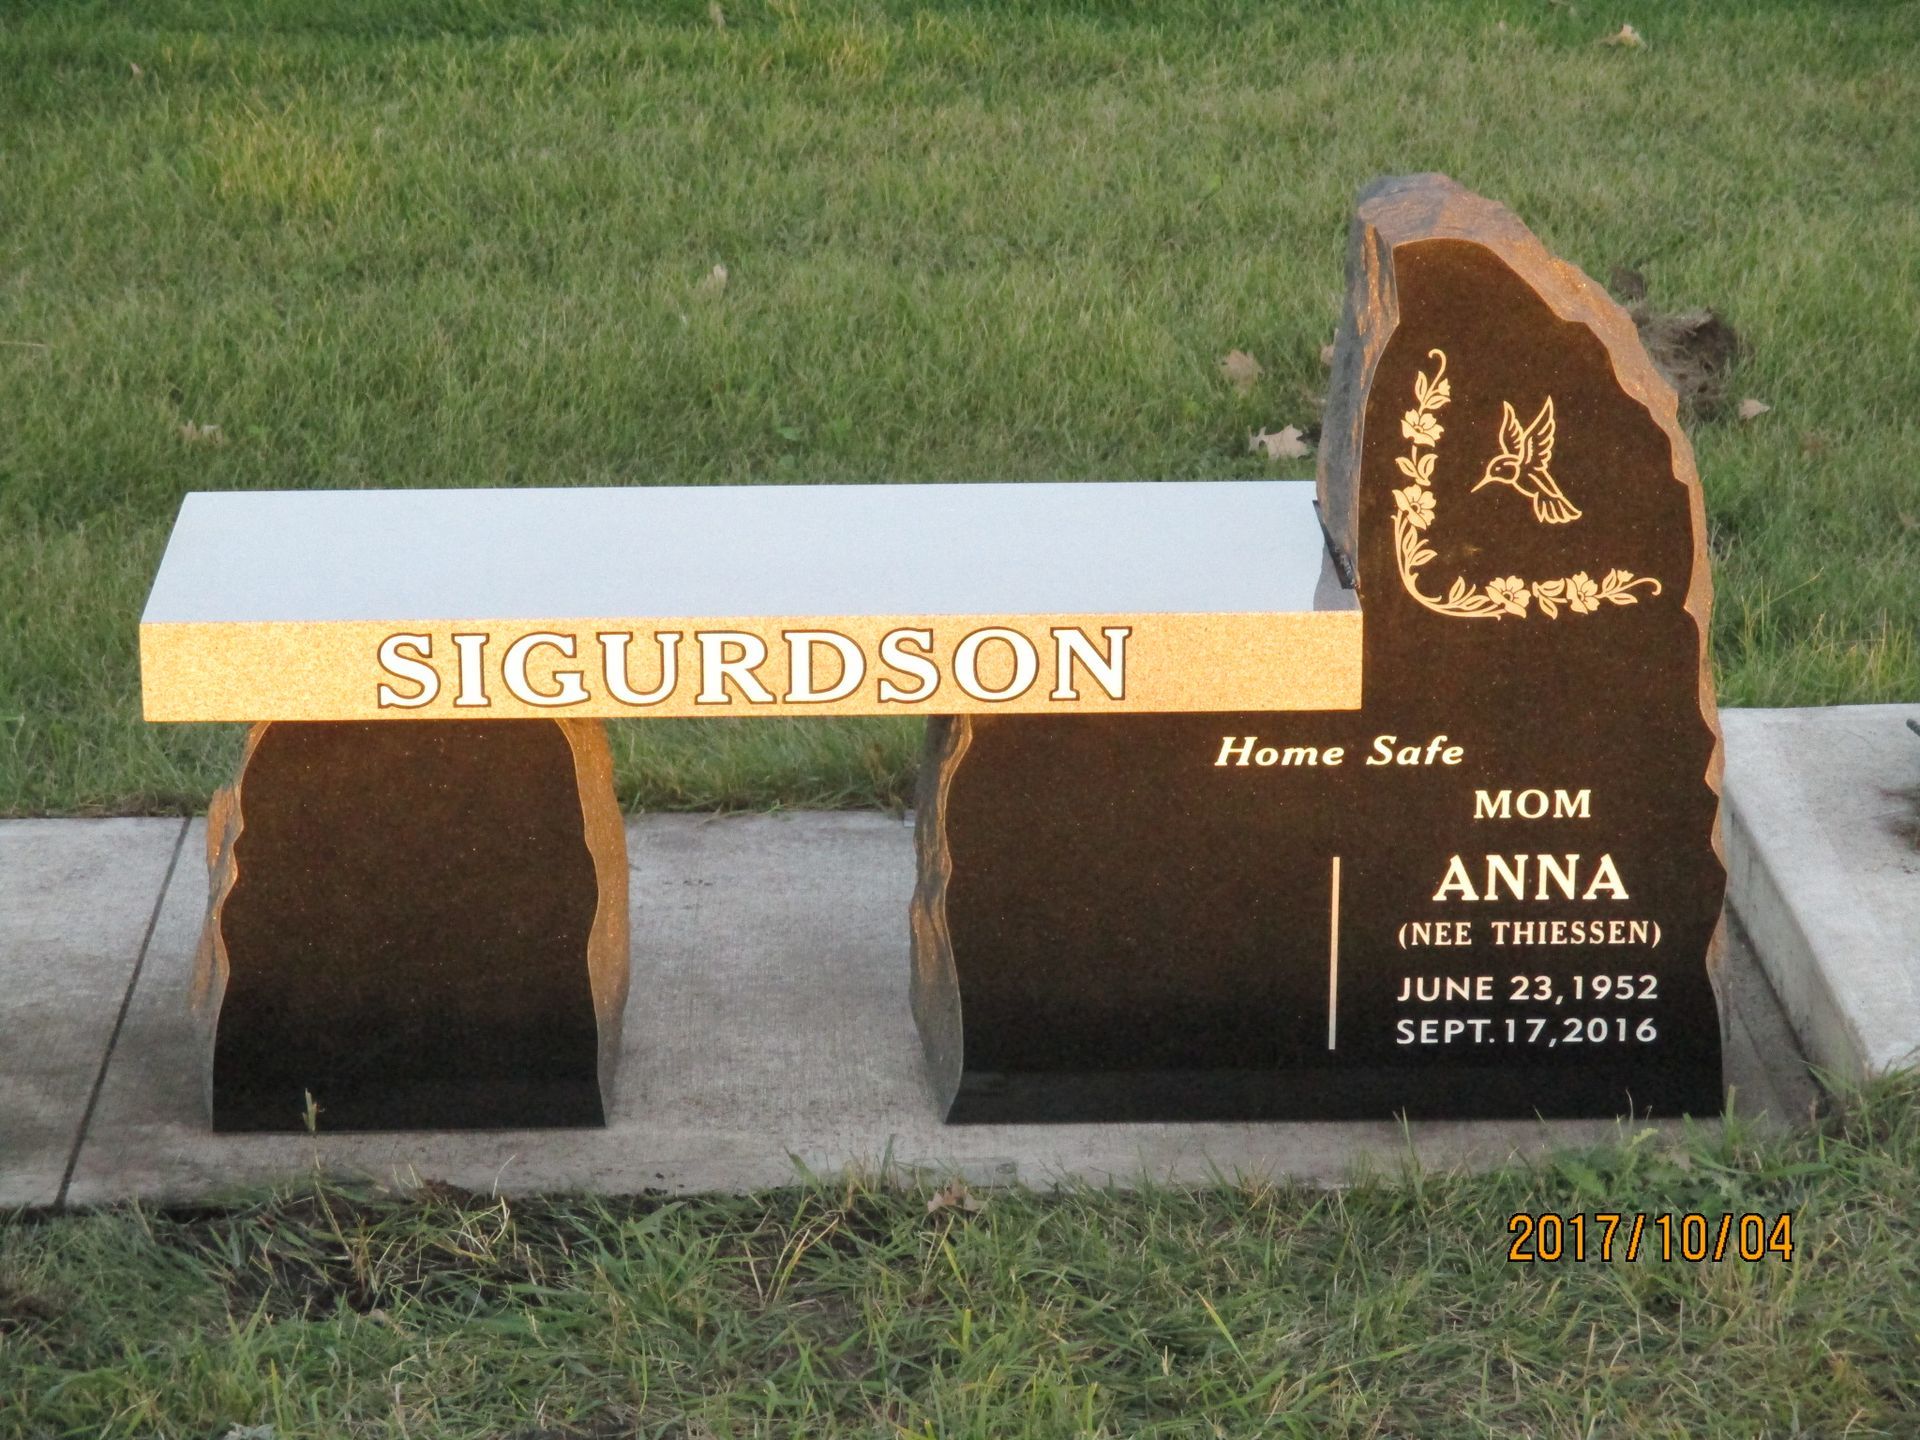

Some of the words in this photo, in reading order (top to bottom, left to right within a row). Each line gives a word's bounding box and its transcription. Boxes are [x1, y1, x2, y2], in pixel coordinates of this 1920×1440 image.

[377, 627, 1131, 708] SIGURDSON
[1213, 735, 1345, 769] Home
[1365, 734, 1465, 767] Safe
[1472, 788, 1592, 820] MOM
[1431, 853, 1630, 902] ANNA
[1398, 921, 1472, 950] (NEE
[1490, 920, 1662, 949] THIESSEN)
[1397, 976, 1494, 1002] JUNE
